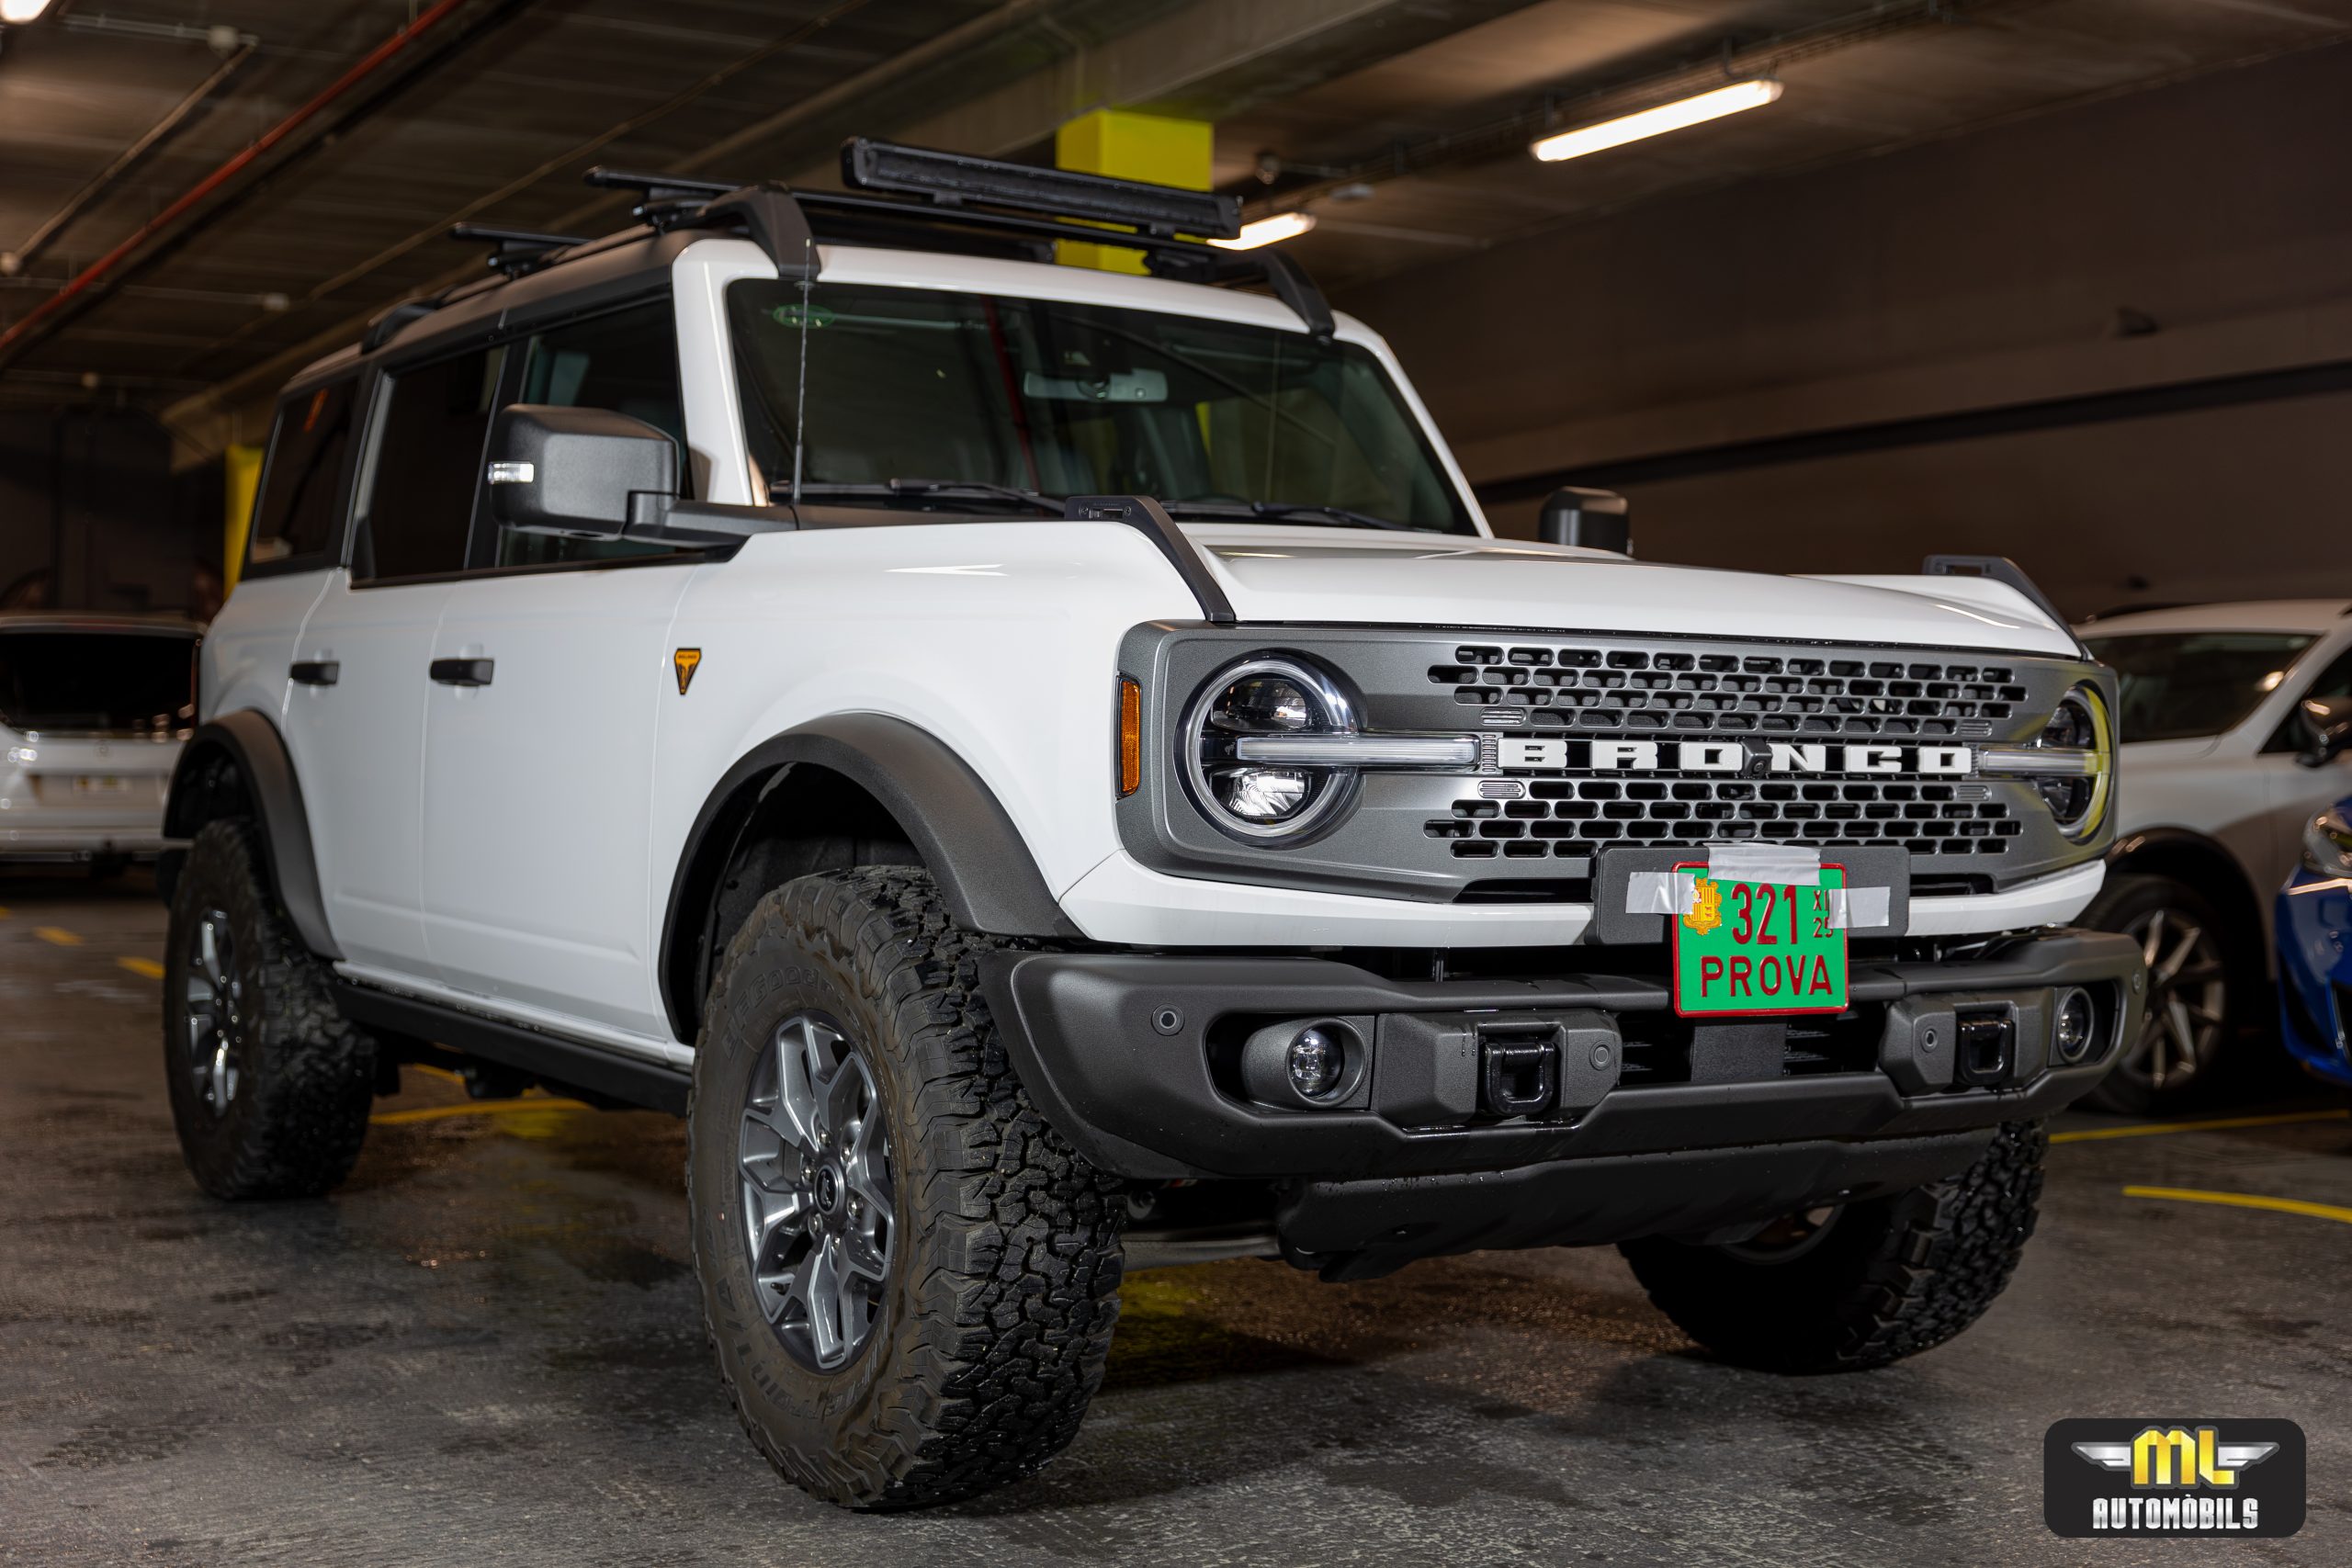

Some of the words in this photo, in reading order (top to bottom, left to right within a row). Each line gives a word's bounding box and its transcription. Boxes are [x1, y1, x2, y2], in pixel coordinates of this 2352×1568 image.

[1498, 739, 1972, 773] BRONCO
[1731, 883, 1798, 944] 321
[1813, 917, 1833, 938] 25
[1701, 954, 1833, 998] PROVA
